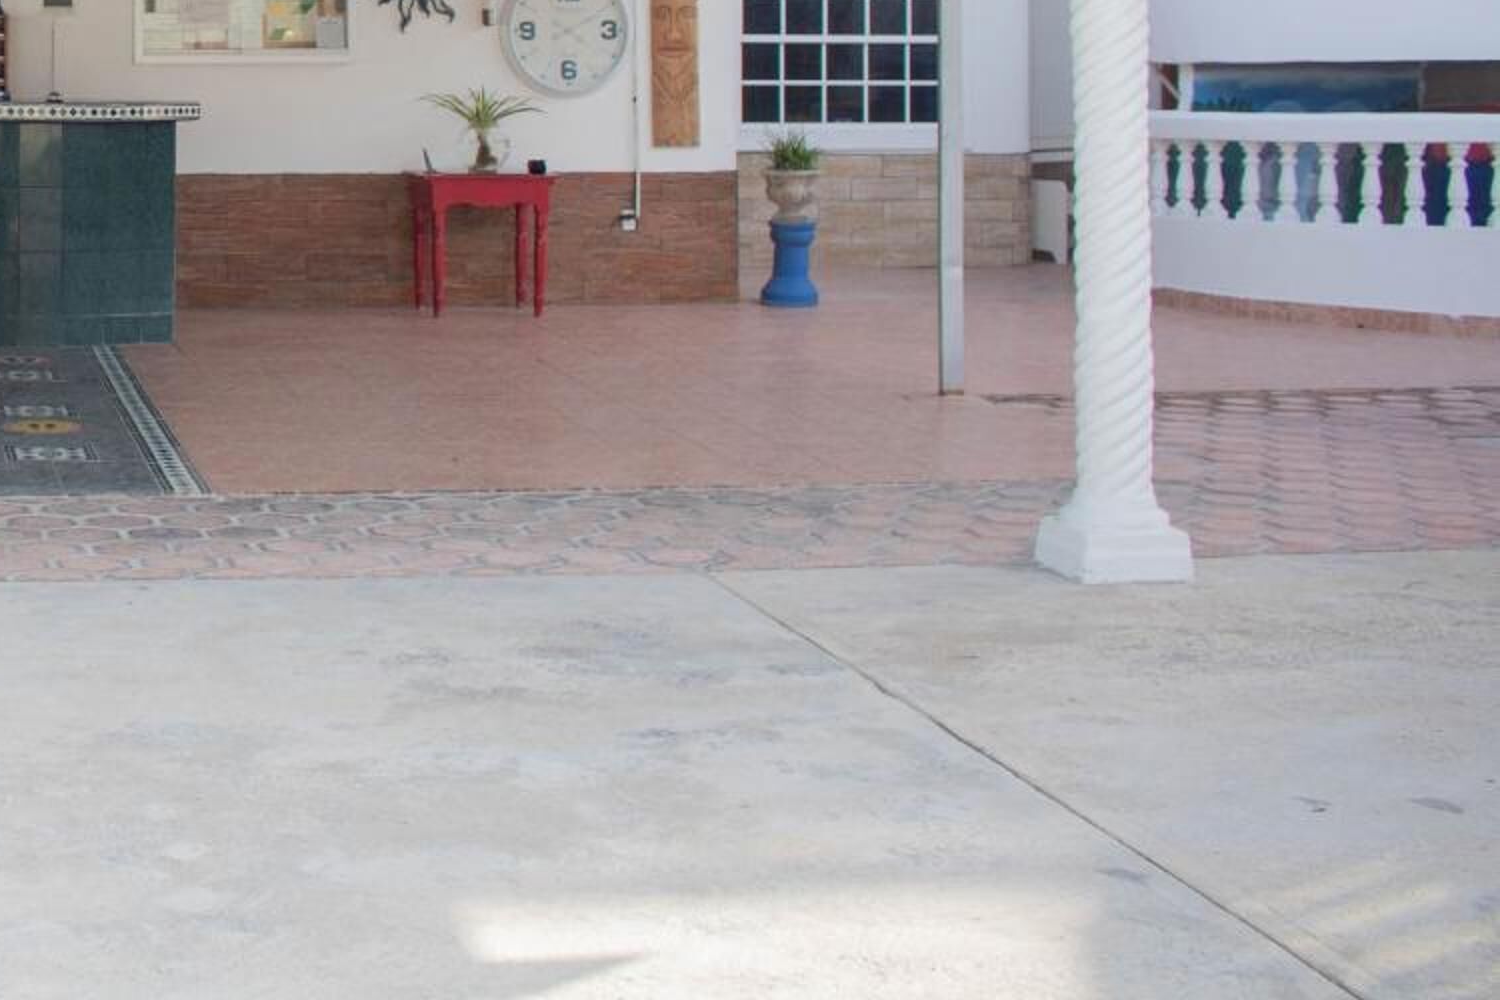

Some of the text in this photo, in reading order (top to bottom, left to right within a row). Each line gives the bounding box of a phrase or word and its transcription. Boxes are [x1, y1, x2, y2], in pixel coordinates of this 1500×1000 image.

[519, 21, 536, 41] 9
[600, 20, 617, 40] 3
[561, 60, 577, 80] 6
